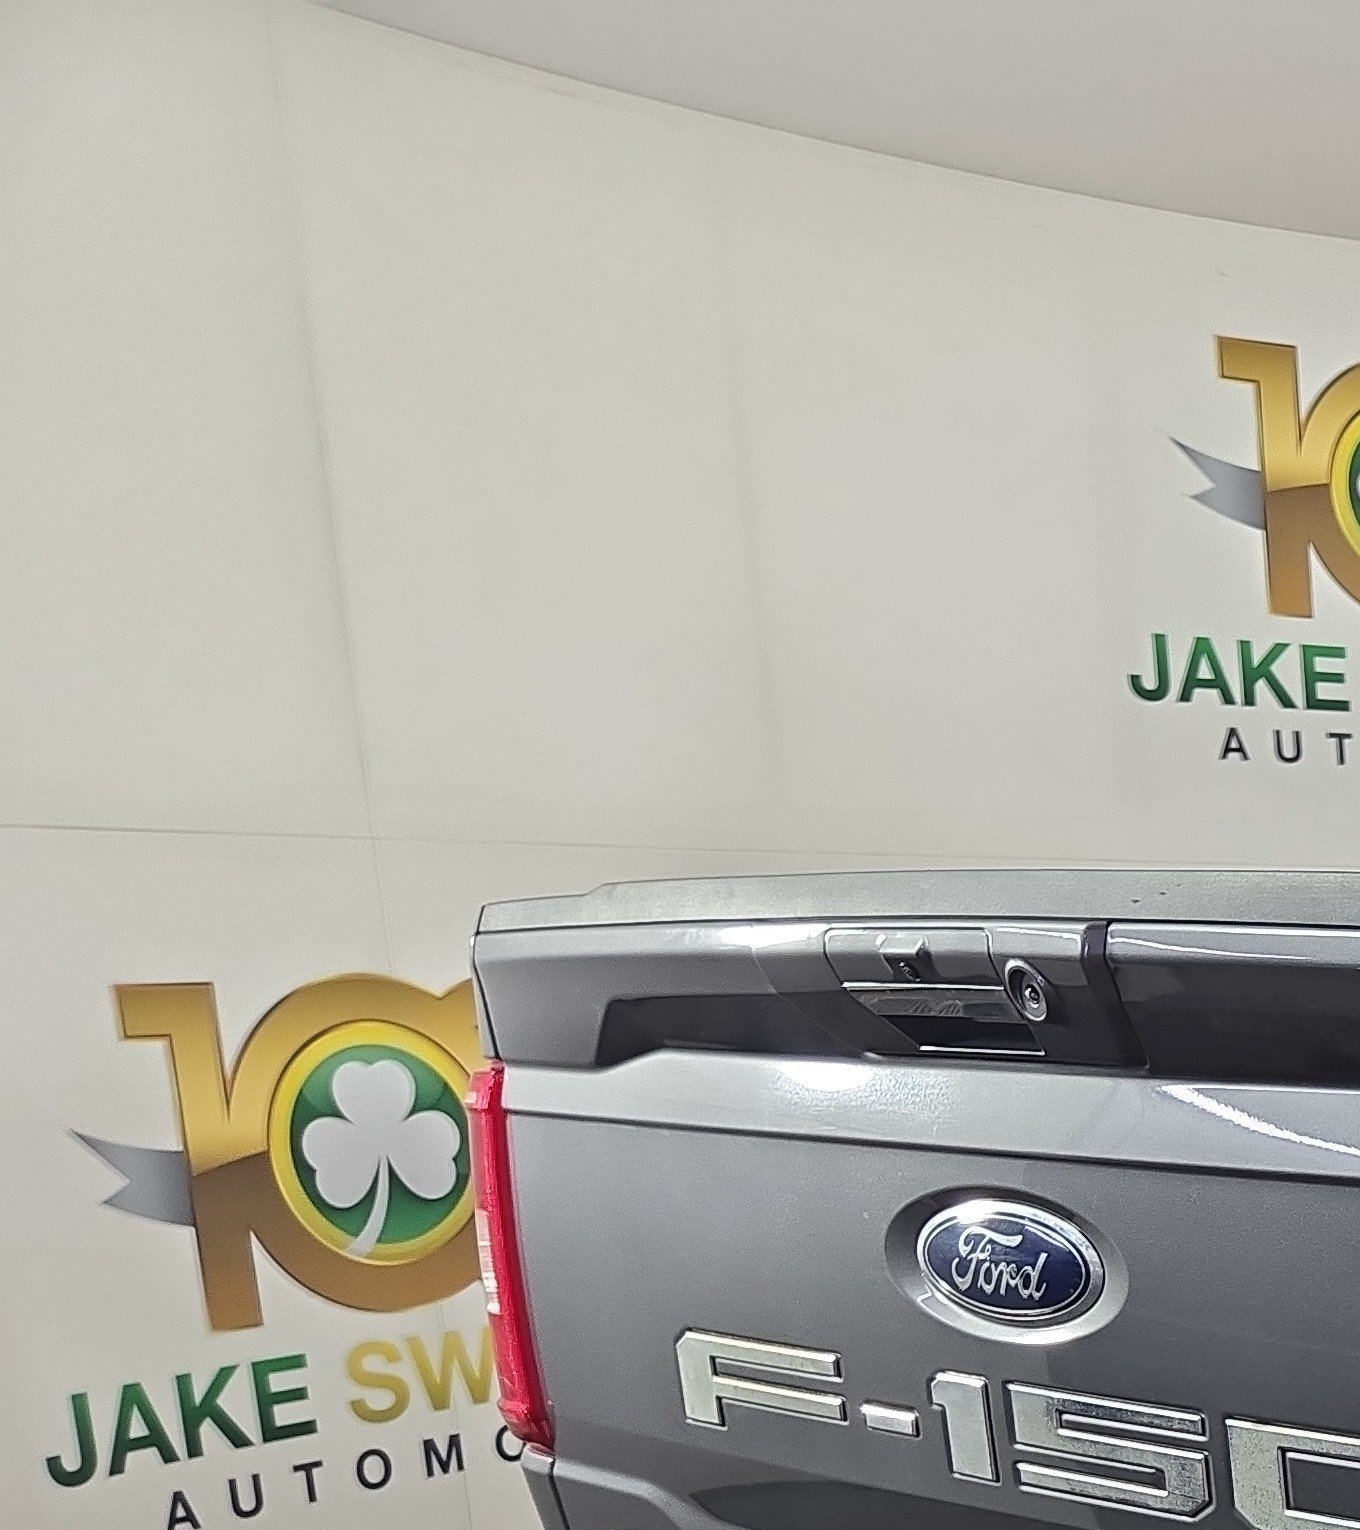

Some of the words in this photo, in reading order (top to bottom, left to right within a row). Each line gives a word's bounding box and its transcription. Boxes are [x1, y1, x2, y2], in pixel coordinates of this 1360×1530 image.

[1126, 632, 1351, 713] JAKE
[951, 1225, 1048, 1300] Ford
[44, 1353, 318, 1489] JAKE
